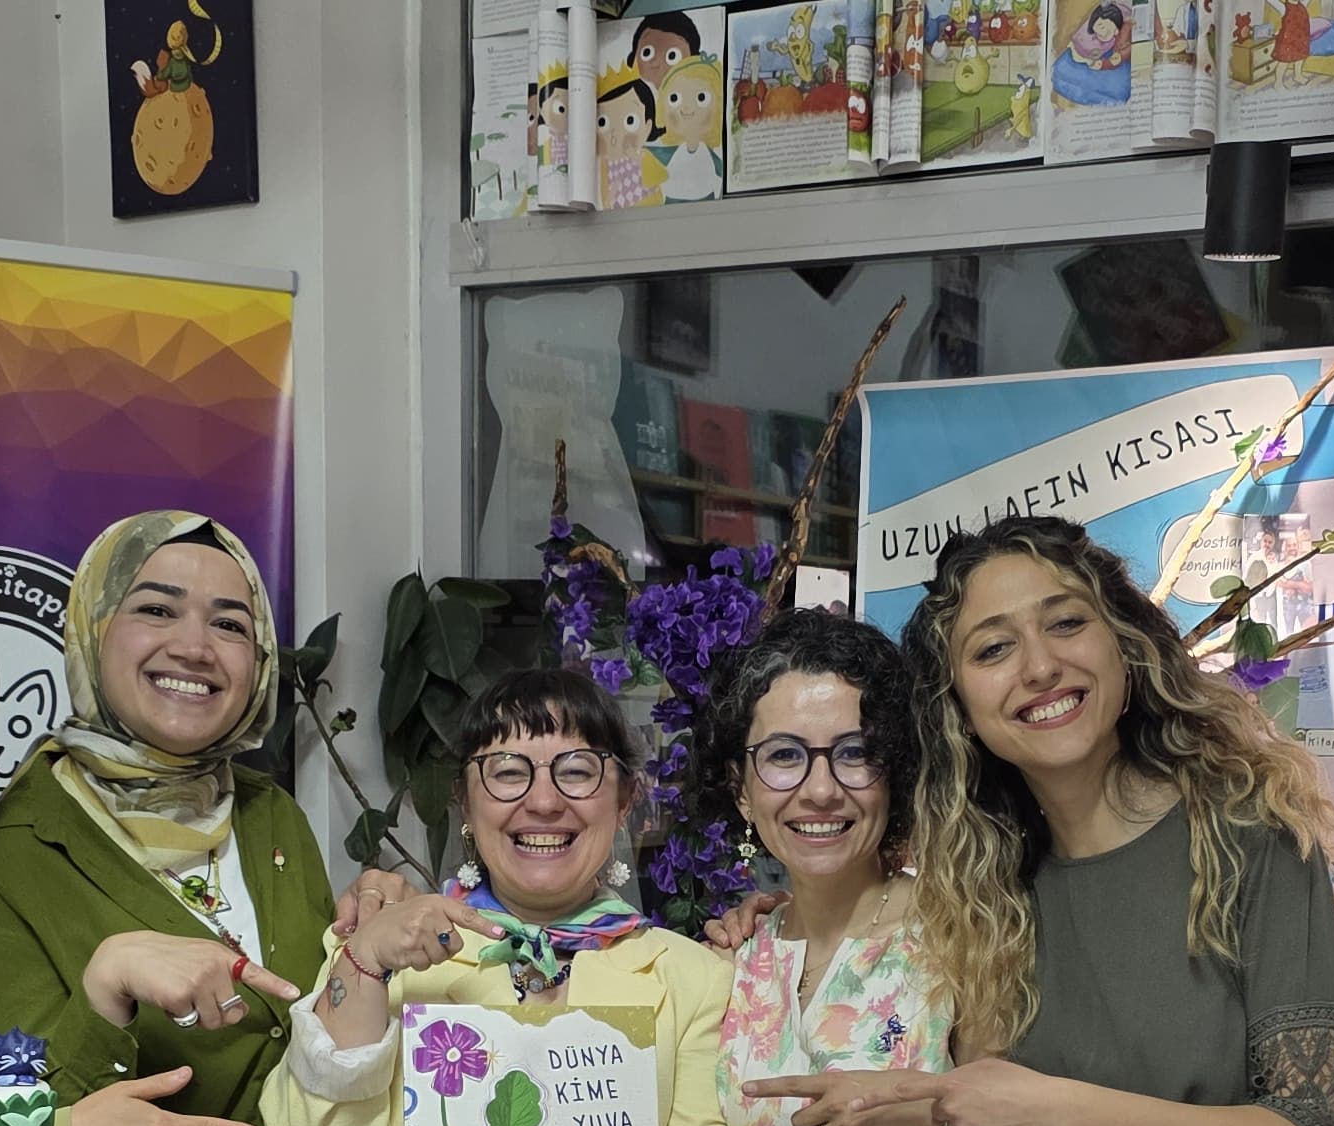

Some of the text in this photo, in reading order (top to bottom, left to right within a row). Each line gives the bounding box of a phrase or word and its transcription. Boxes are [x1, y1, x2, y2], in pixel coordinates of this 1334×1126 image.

[881, 408, 1244, 561] UZUN LAFIN KISASI
[548, 1044, 624, 1070] DÜNYA
[555, 1076, 620, 1105] KİME
